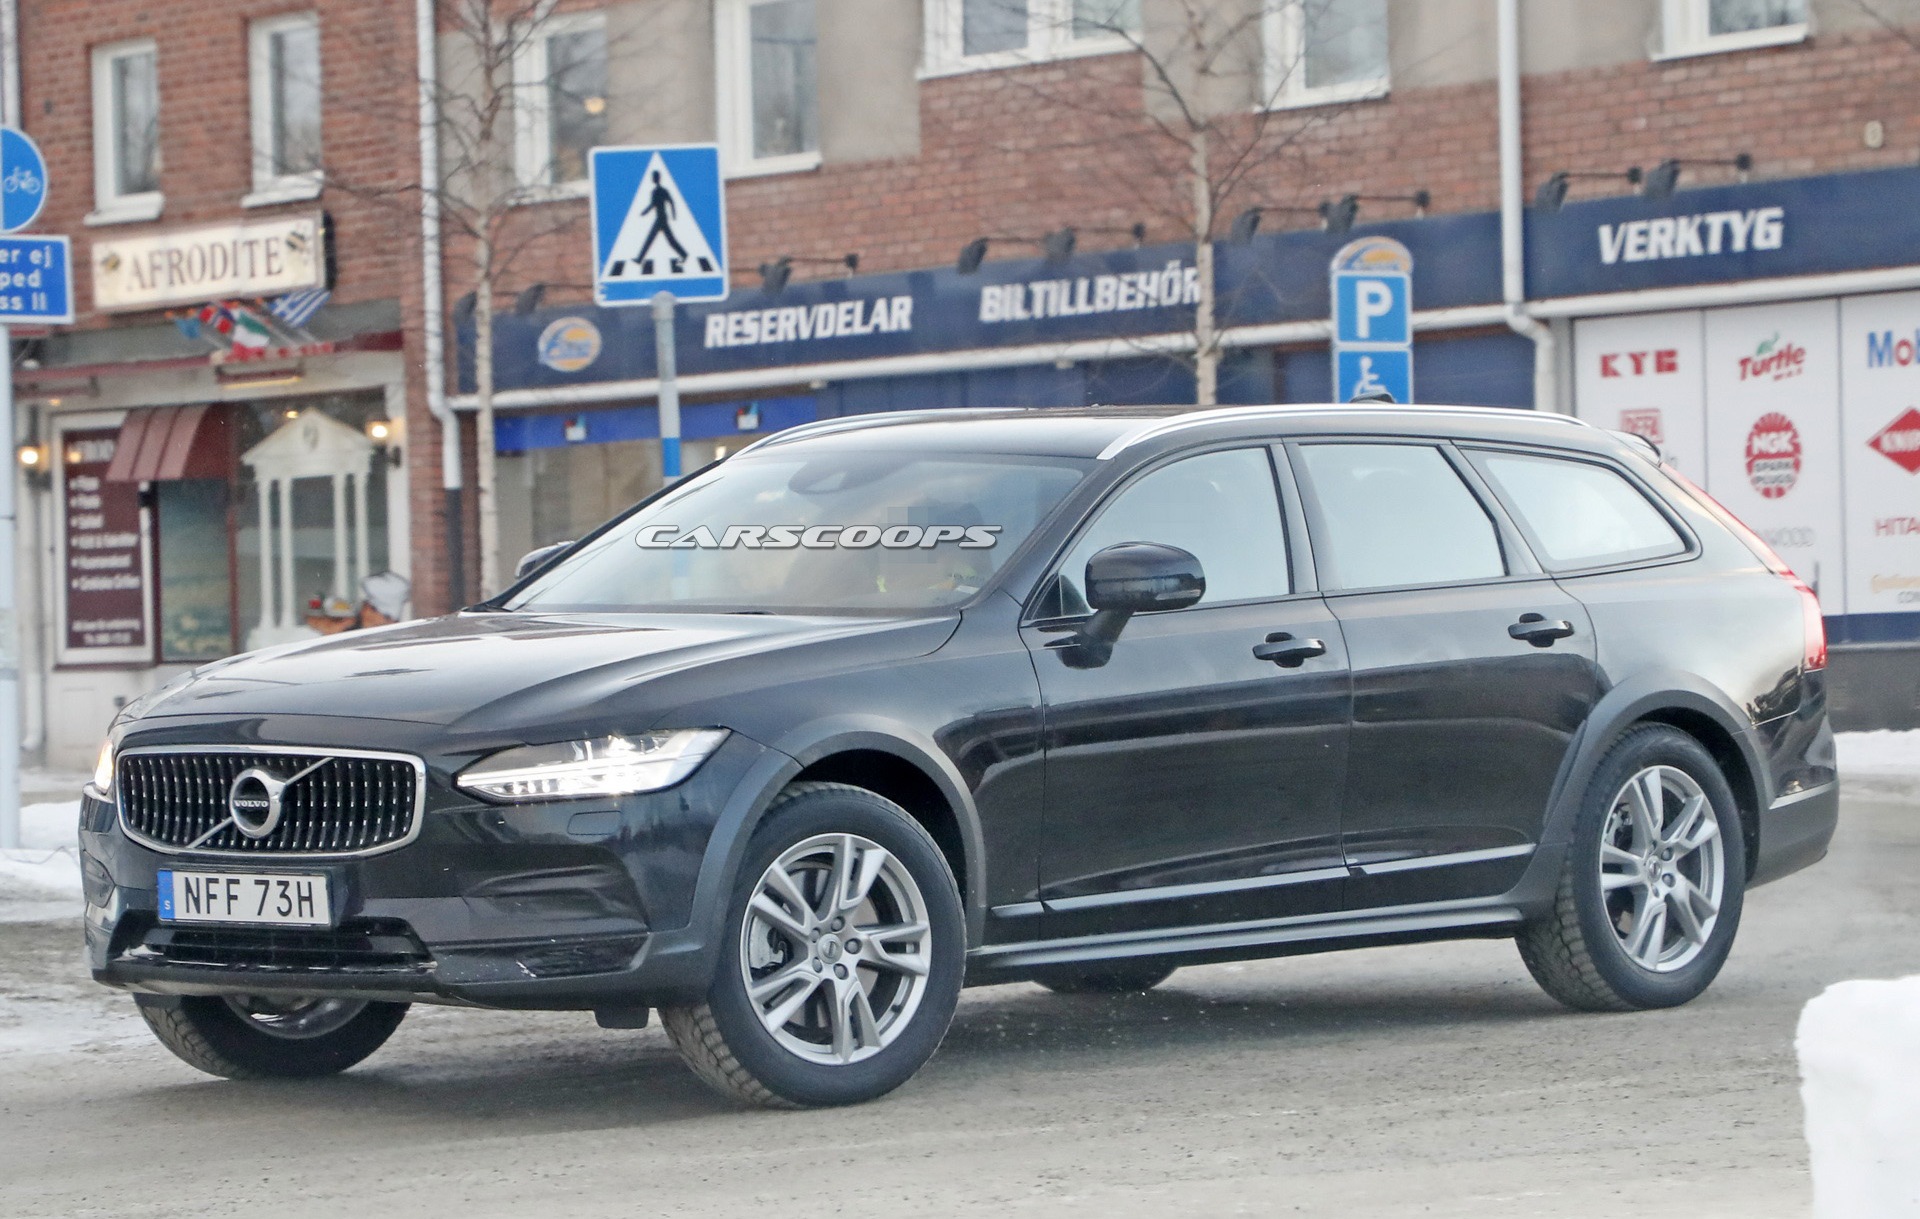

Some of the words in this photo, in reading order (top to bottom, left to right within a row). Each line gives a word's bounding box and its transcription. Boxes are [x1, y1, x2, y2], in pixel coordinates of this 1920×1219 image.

[1598, 206, 1785, 265] VERKTYG
[29, 244, 52, 270] ej
[126, 236, 284, 291] AFRODITE
[704, 296, 913, 349] RESERVDELAR
[1355, 280, 1394, 339] P
[1738, 342, 1806, 381] Turtle
[1751, 431, 1794, 456] NGK
[233, 800, 269, 808] VOLVO
[164, 900, 171, 910] S
[185, 876, 241, 916] NFF
[254, 879, 314, 918] 73H
